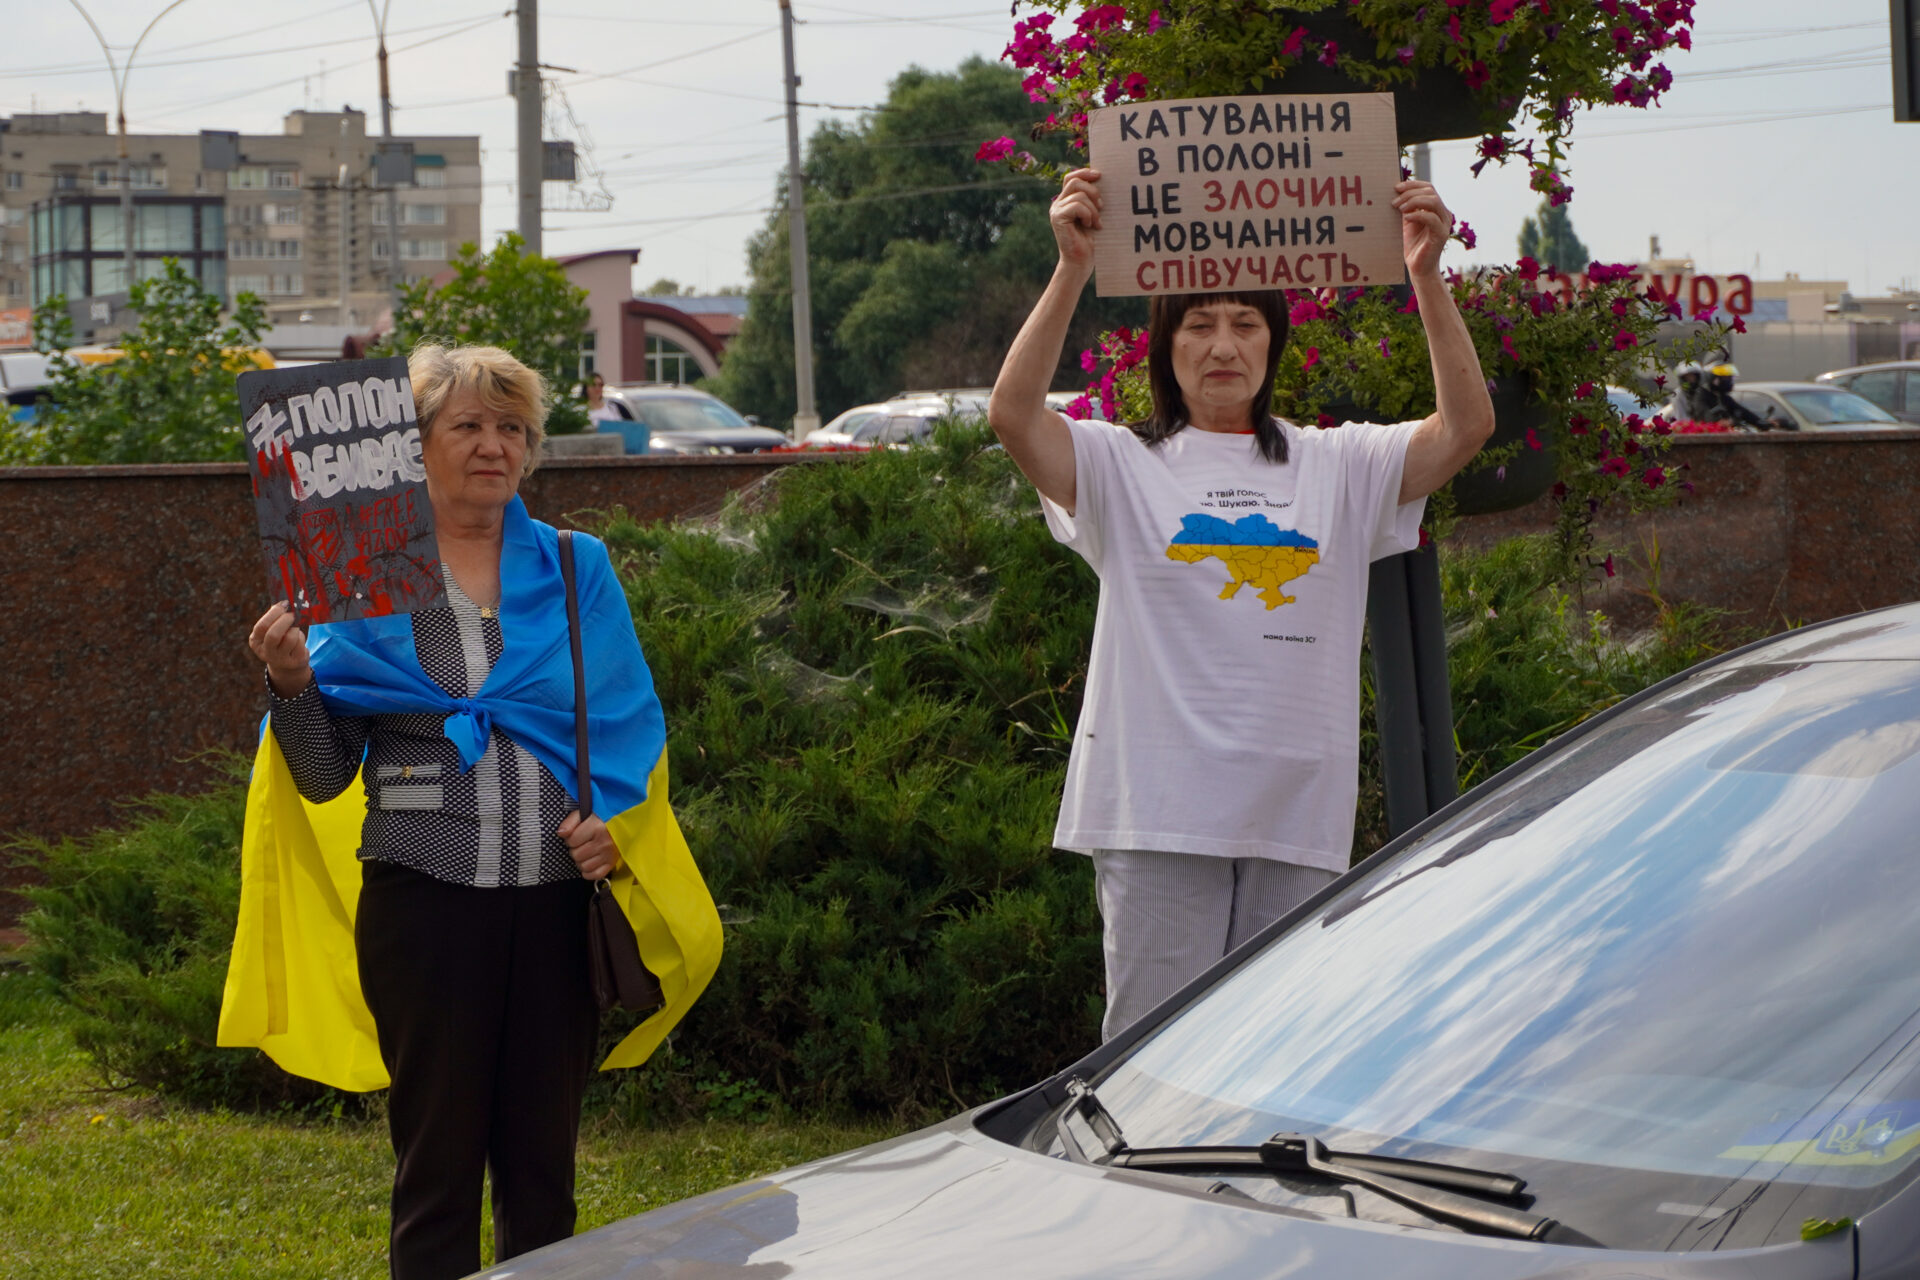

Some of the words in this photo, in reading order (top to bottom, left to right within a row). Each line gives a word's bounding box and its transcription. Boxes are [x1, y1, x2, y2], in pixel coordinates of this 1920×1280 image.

[1119, 101, 1351, 141] КАТУВАННЯ
[1138, 147, 1160, 176] В
[1131, 182, 1182, 219] ЦЕ
[1203, 175, 1373, 213] ЗЛОЧИН.
[1133, 216, 1336, 253] МОВЧАННЯ
[246, 376, 417, 460] #ПОЛОН
[290, 428, 427, 501] ВБИВАЄ
